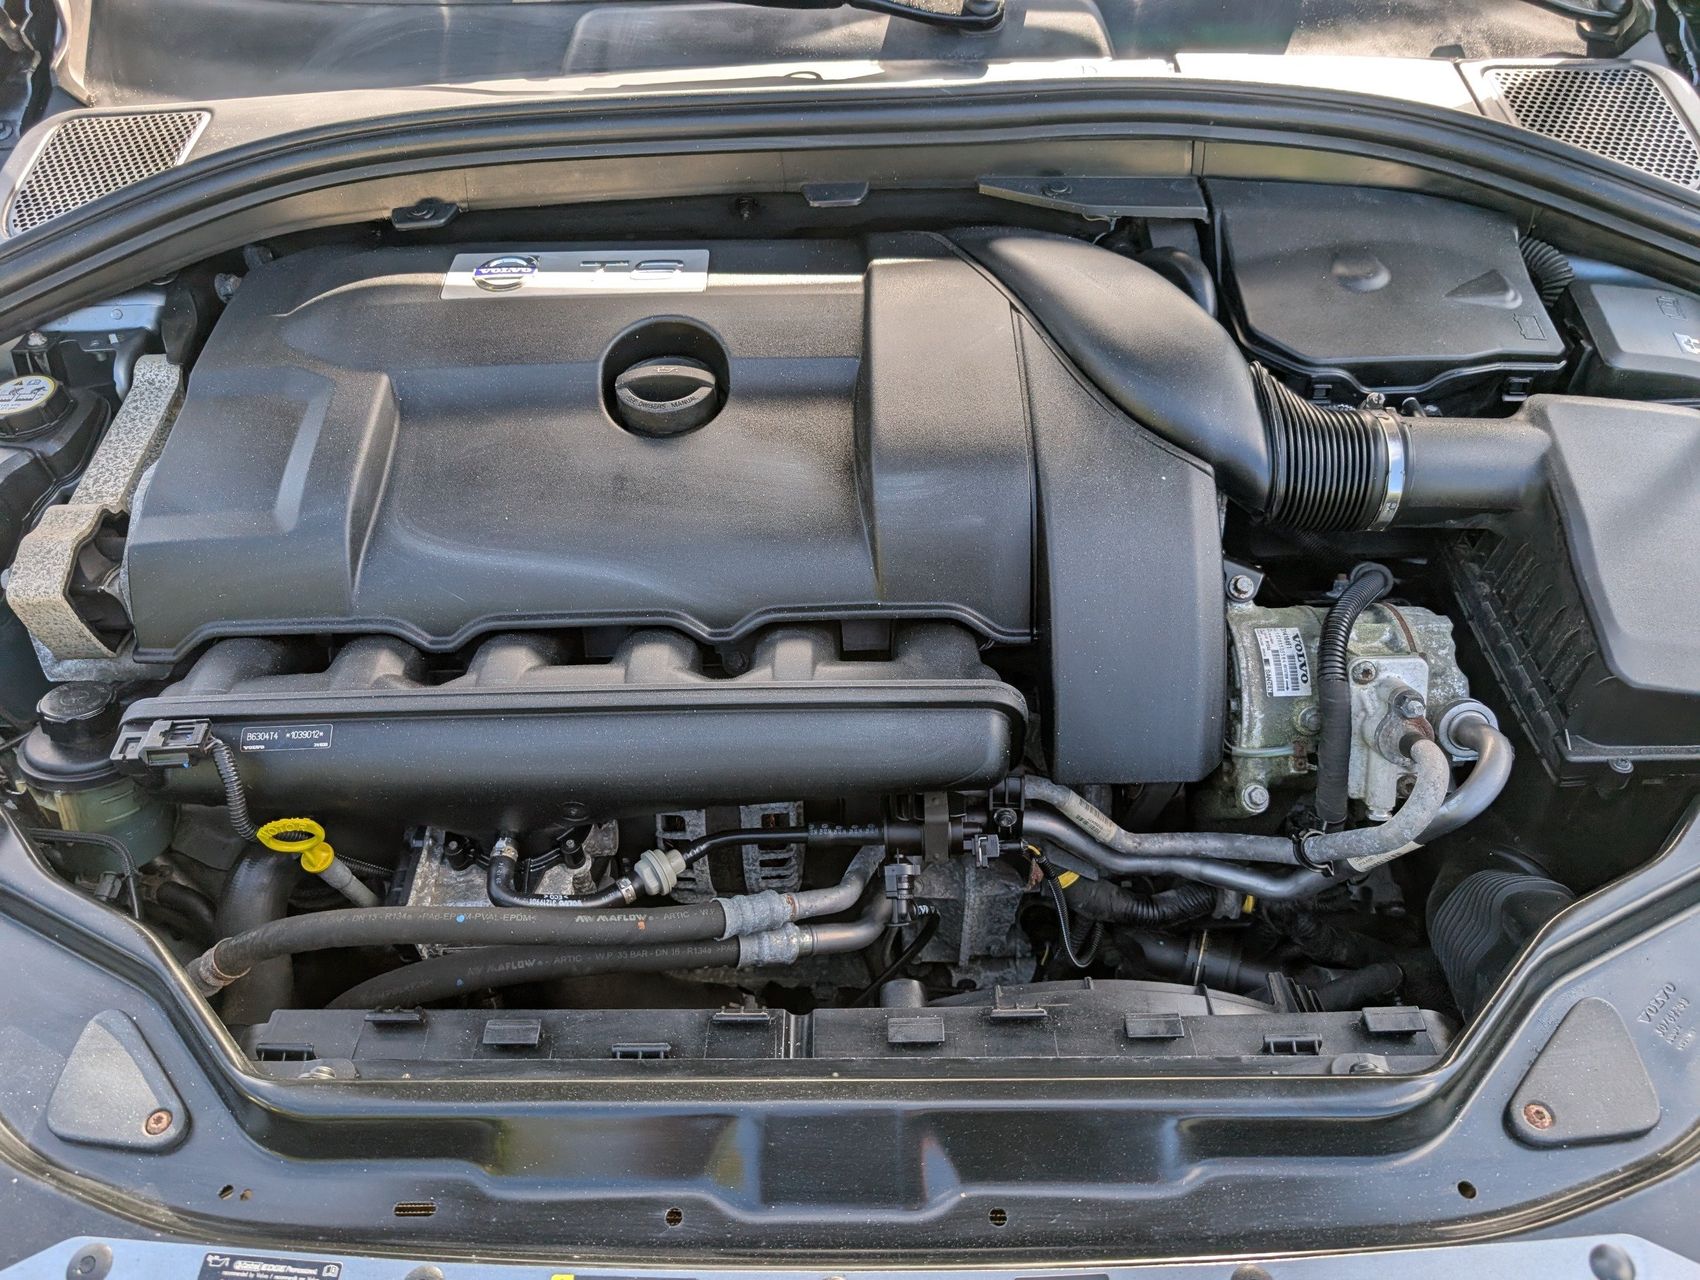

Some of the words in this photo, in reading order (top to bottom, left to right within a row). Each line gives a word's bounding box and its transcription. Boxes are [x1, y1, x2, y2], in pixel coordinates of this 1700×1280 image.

[480, 267, 531, 276] VOLVO
[670, 396, 698, 409] MANUAL
[1292, 633, 1309, 684] VOLVO
[246, 732, 278, 741] B6304T4
[596, 913, 648, 922] MAFLOW
[664, 910, 690, 920] ARTIC
[554, 954, 583, 965] ARTIC
[629, 950, 648, 958] BAR
[1637, 982, 1677, 1024] VOLVO
